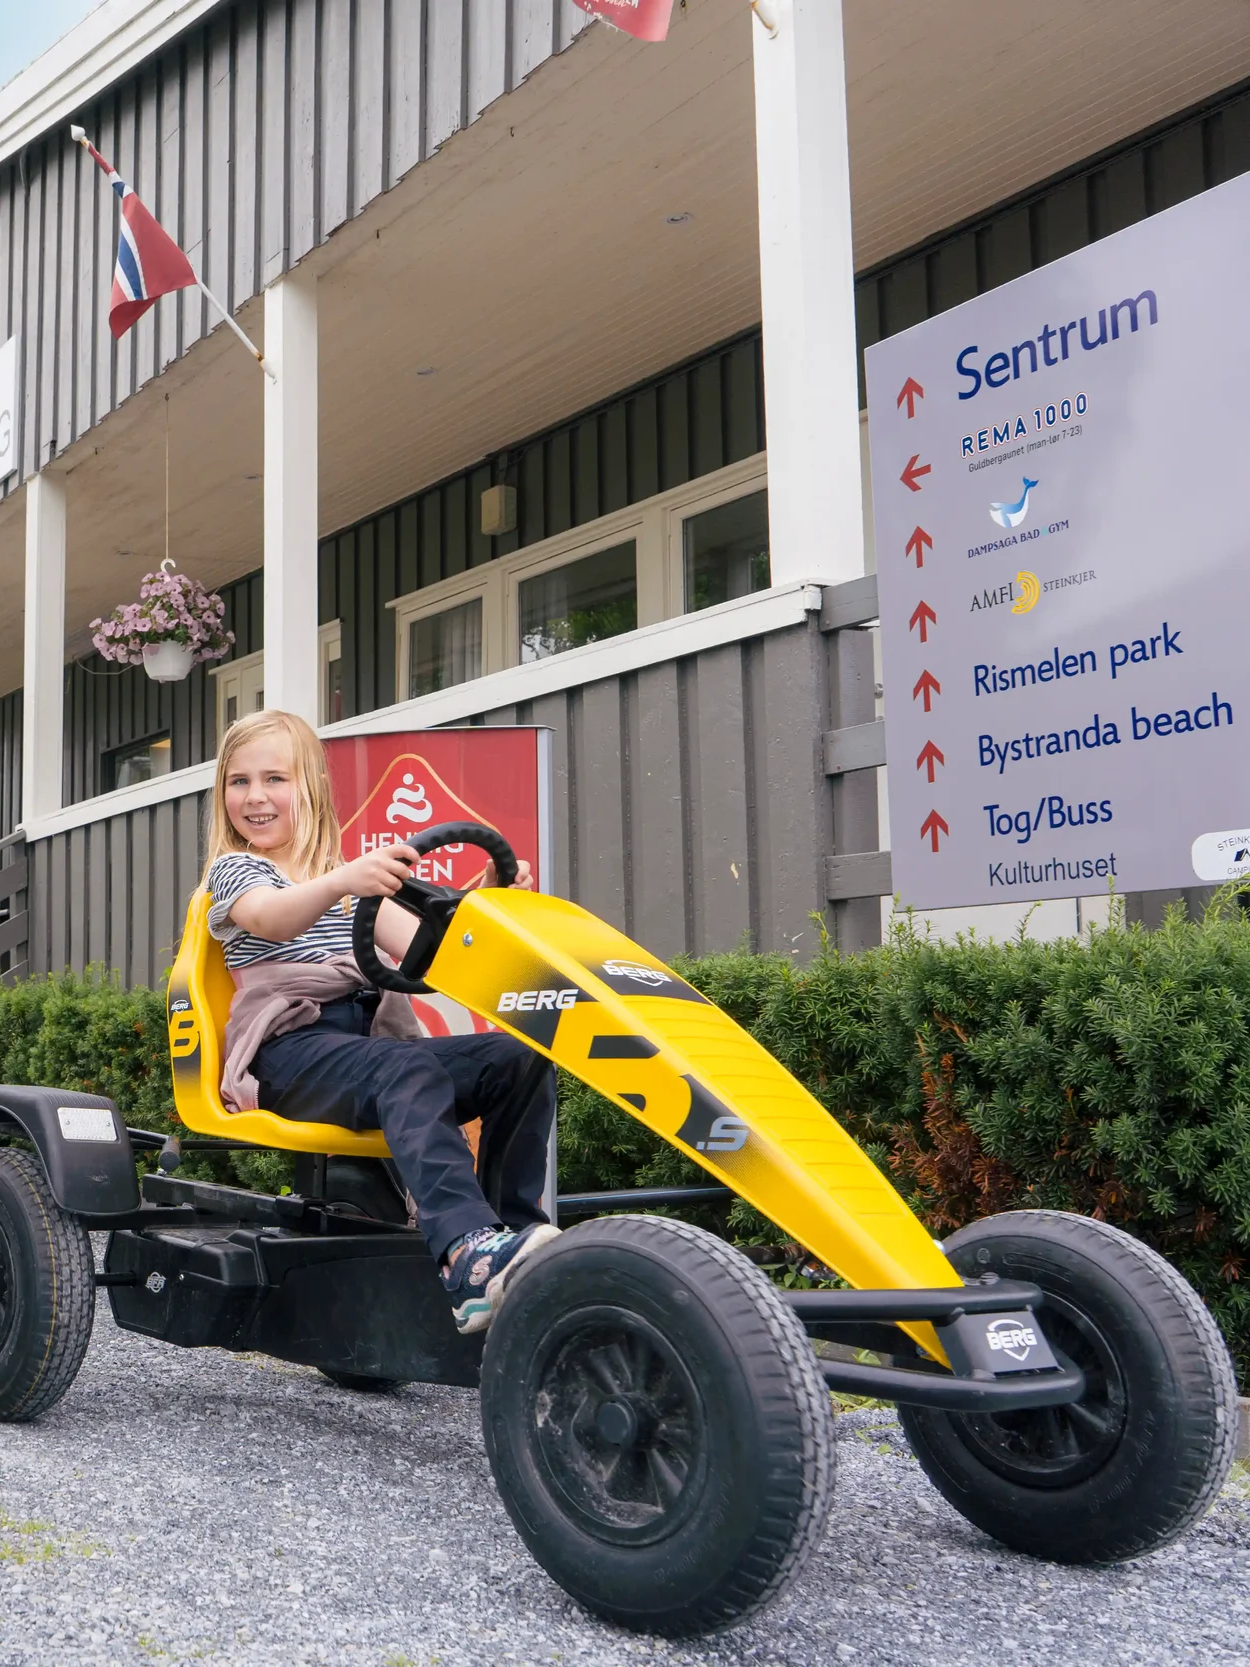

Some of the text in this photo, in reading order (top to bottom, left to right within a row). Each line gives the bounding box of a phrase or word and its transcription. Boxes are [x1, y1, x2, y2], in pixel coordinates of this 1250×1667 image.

[956, 289, 1159, 401] Sentrum
[961, 392, 1088, 458] REMA 1000
[968, 446, 1025, 472] Guldbergaunet
[1061, 424, 1083, 442] 7-23)
[967, 535, 1018, 559] DAMPSAGA
[1020, 528, 1040, 543] BAD
[1048, 519, 1070, 534] GYM
[970, 569, 1097, 612] AMFI STEINKJER
[973, 621, 1184, 696] Rismelen park
[978, 691, 1234, 775] Bystranda beach
[983, 795, 1114, 844] Tog/Buss
[989, 853, 1118, 887] Kulturhuset
[601, 963, 673, 983] BERG
[496, 988, 579, 1012] BERG
[985, 1328, 1038, 1351] BERG
